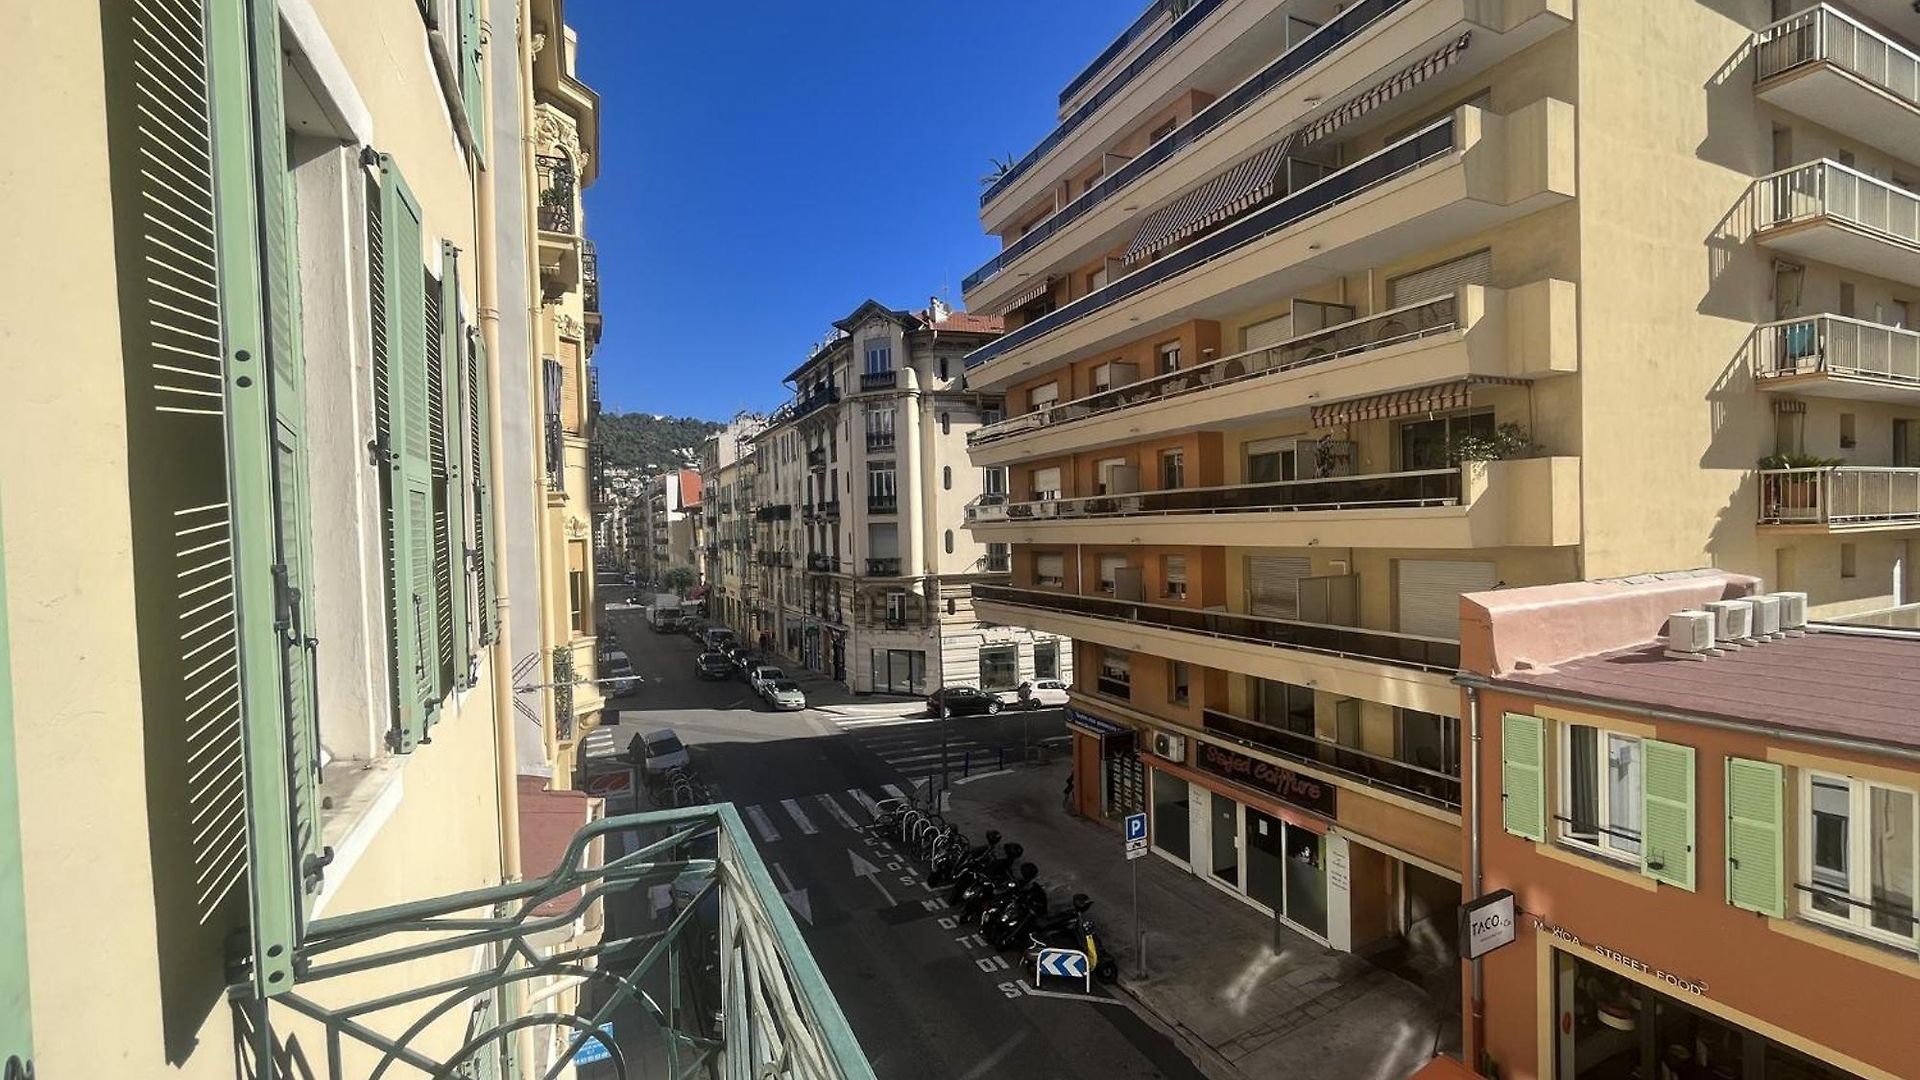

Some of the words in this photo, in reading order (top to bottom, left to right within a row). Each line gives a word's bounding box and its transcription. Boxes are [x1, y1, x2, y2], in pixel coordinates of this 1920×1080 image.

[1131, 819, 1141, 836] P
[1471, 914, 1500, 936] TACO
[921, 899, 1022, 998] MOTOS
[1595, 945, 1650, 973] STREET
[1656, 969, 1702, 996] FOOD
